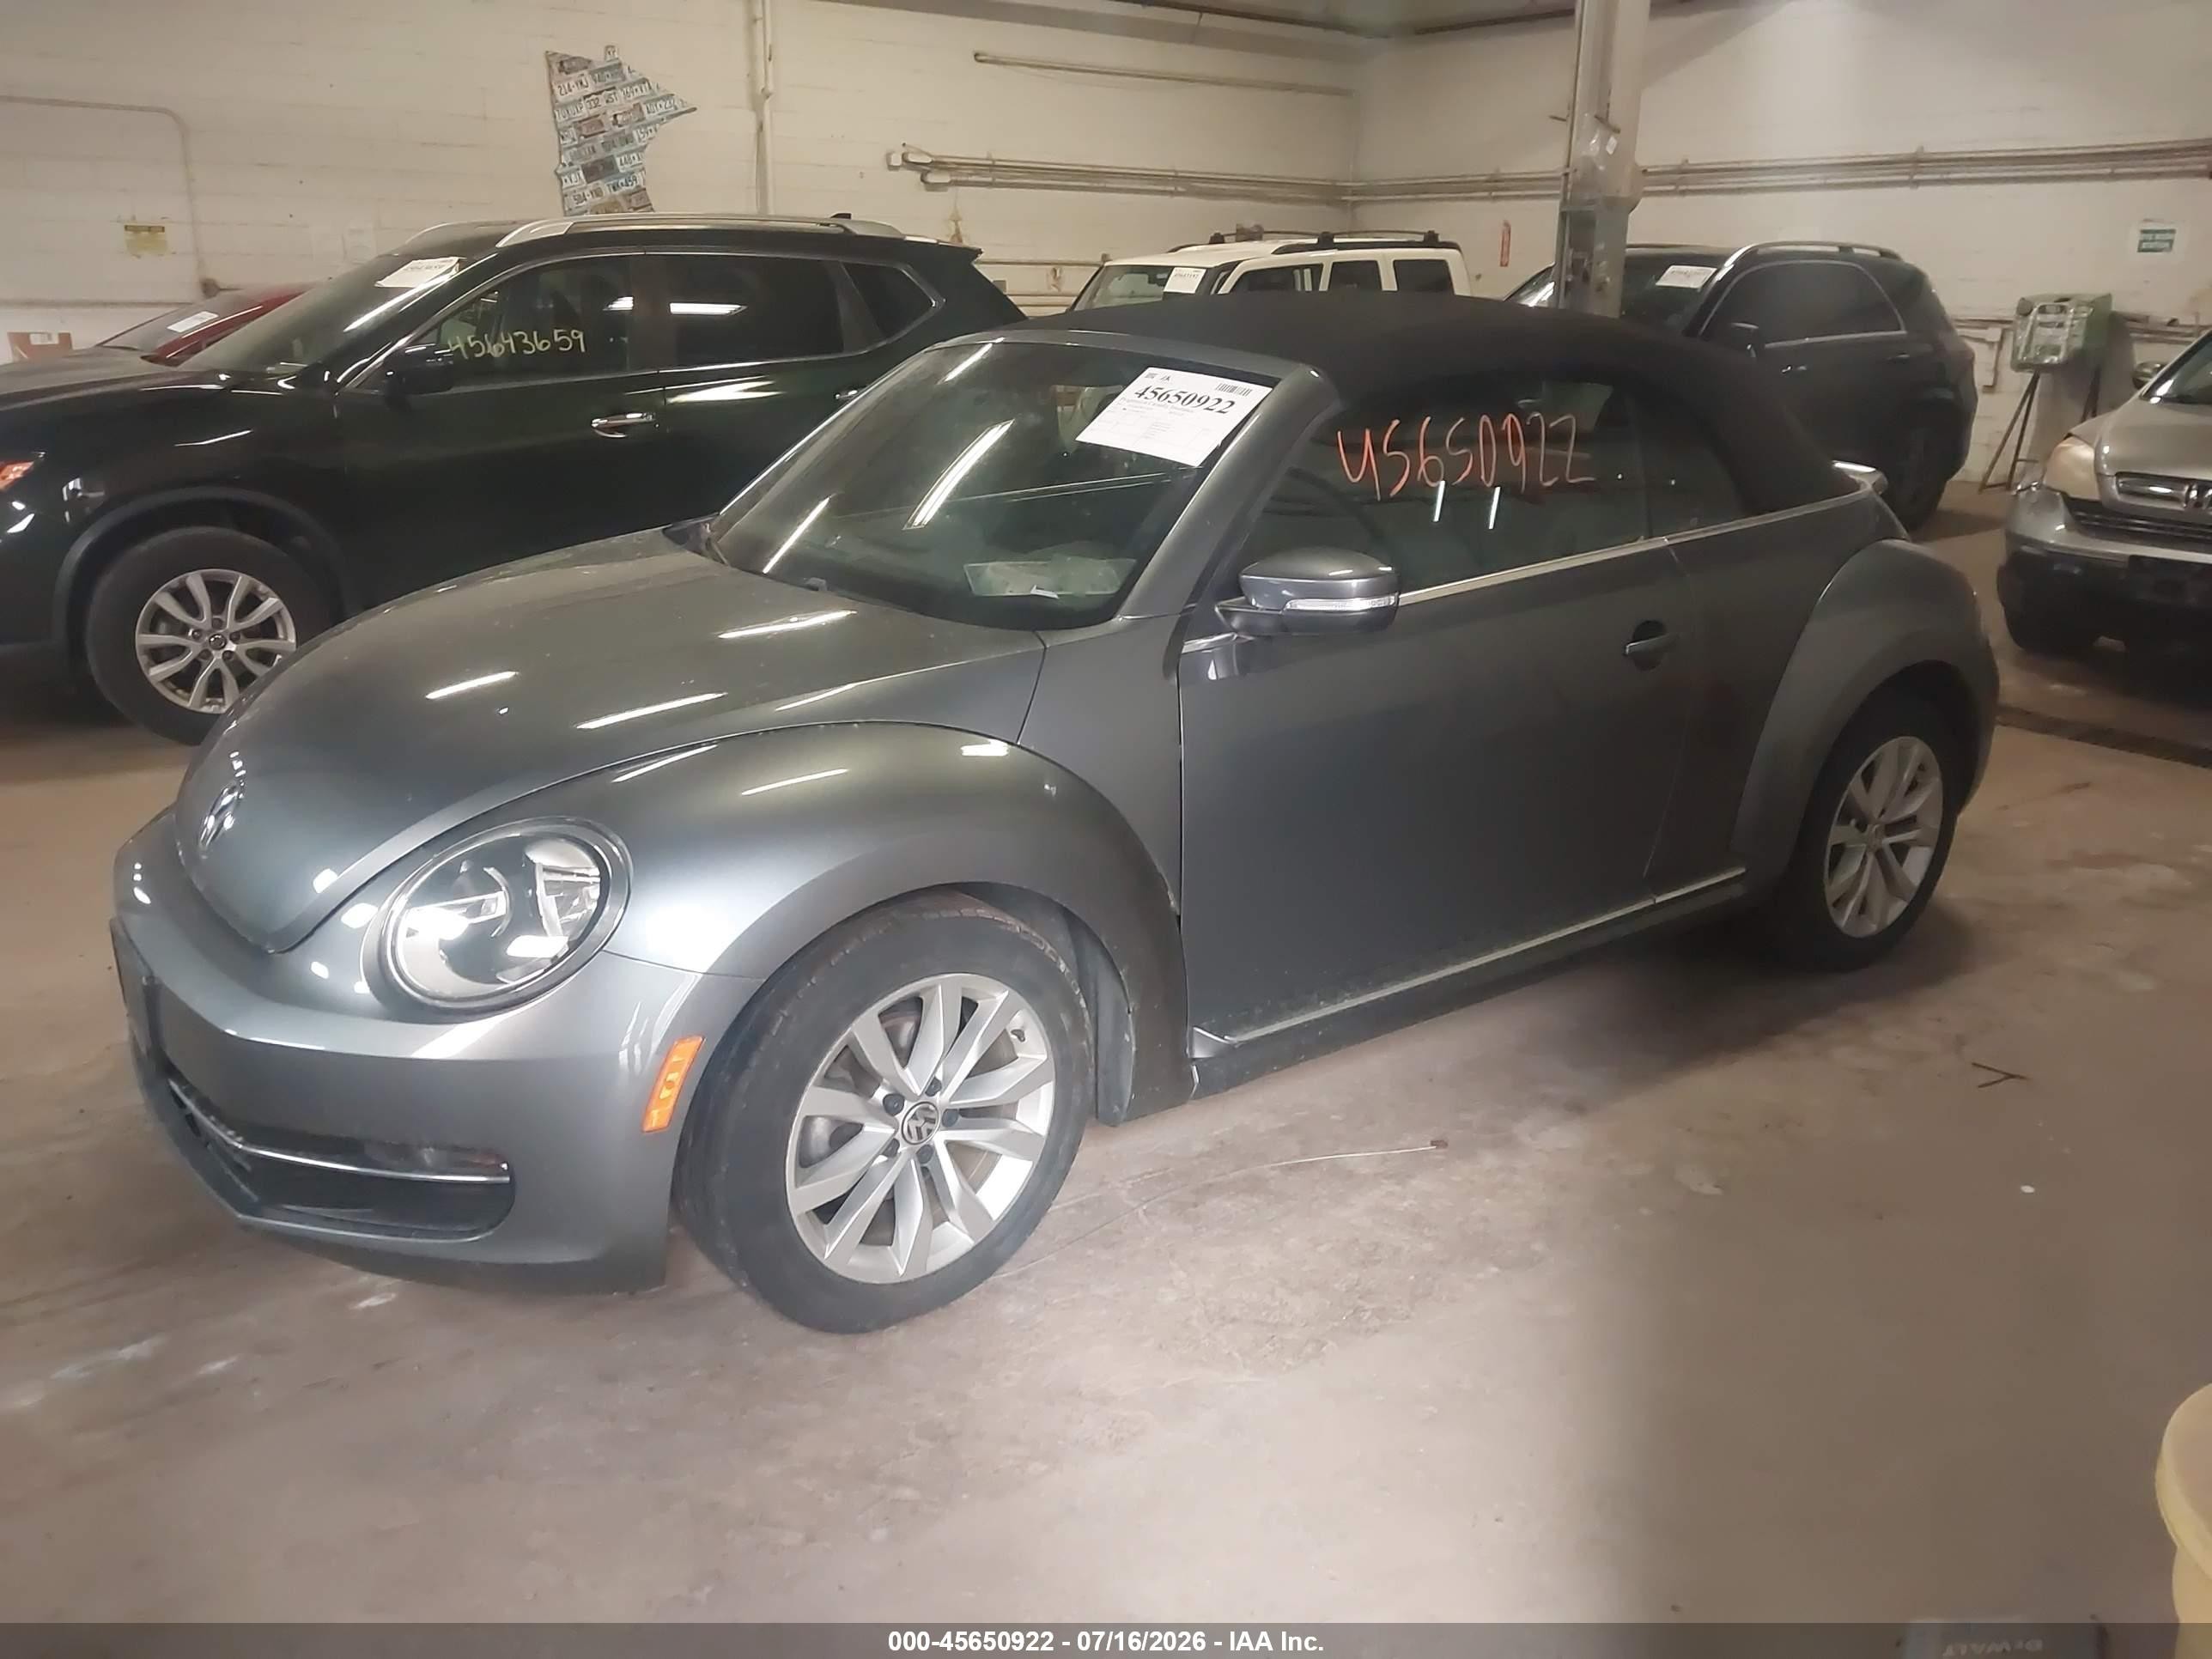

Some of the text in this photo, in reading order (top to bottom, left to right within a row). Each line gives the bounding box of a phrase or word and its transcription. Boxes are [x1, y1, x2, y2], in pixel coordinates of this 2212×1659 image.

[447, 329, 586, 360] 45643659
[1134, 385, 1237, 414] 45650922
[1336, 412, 1596, 501] 45650922
